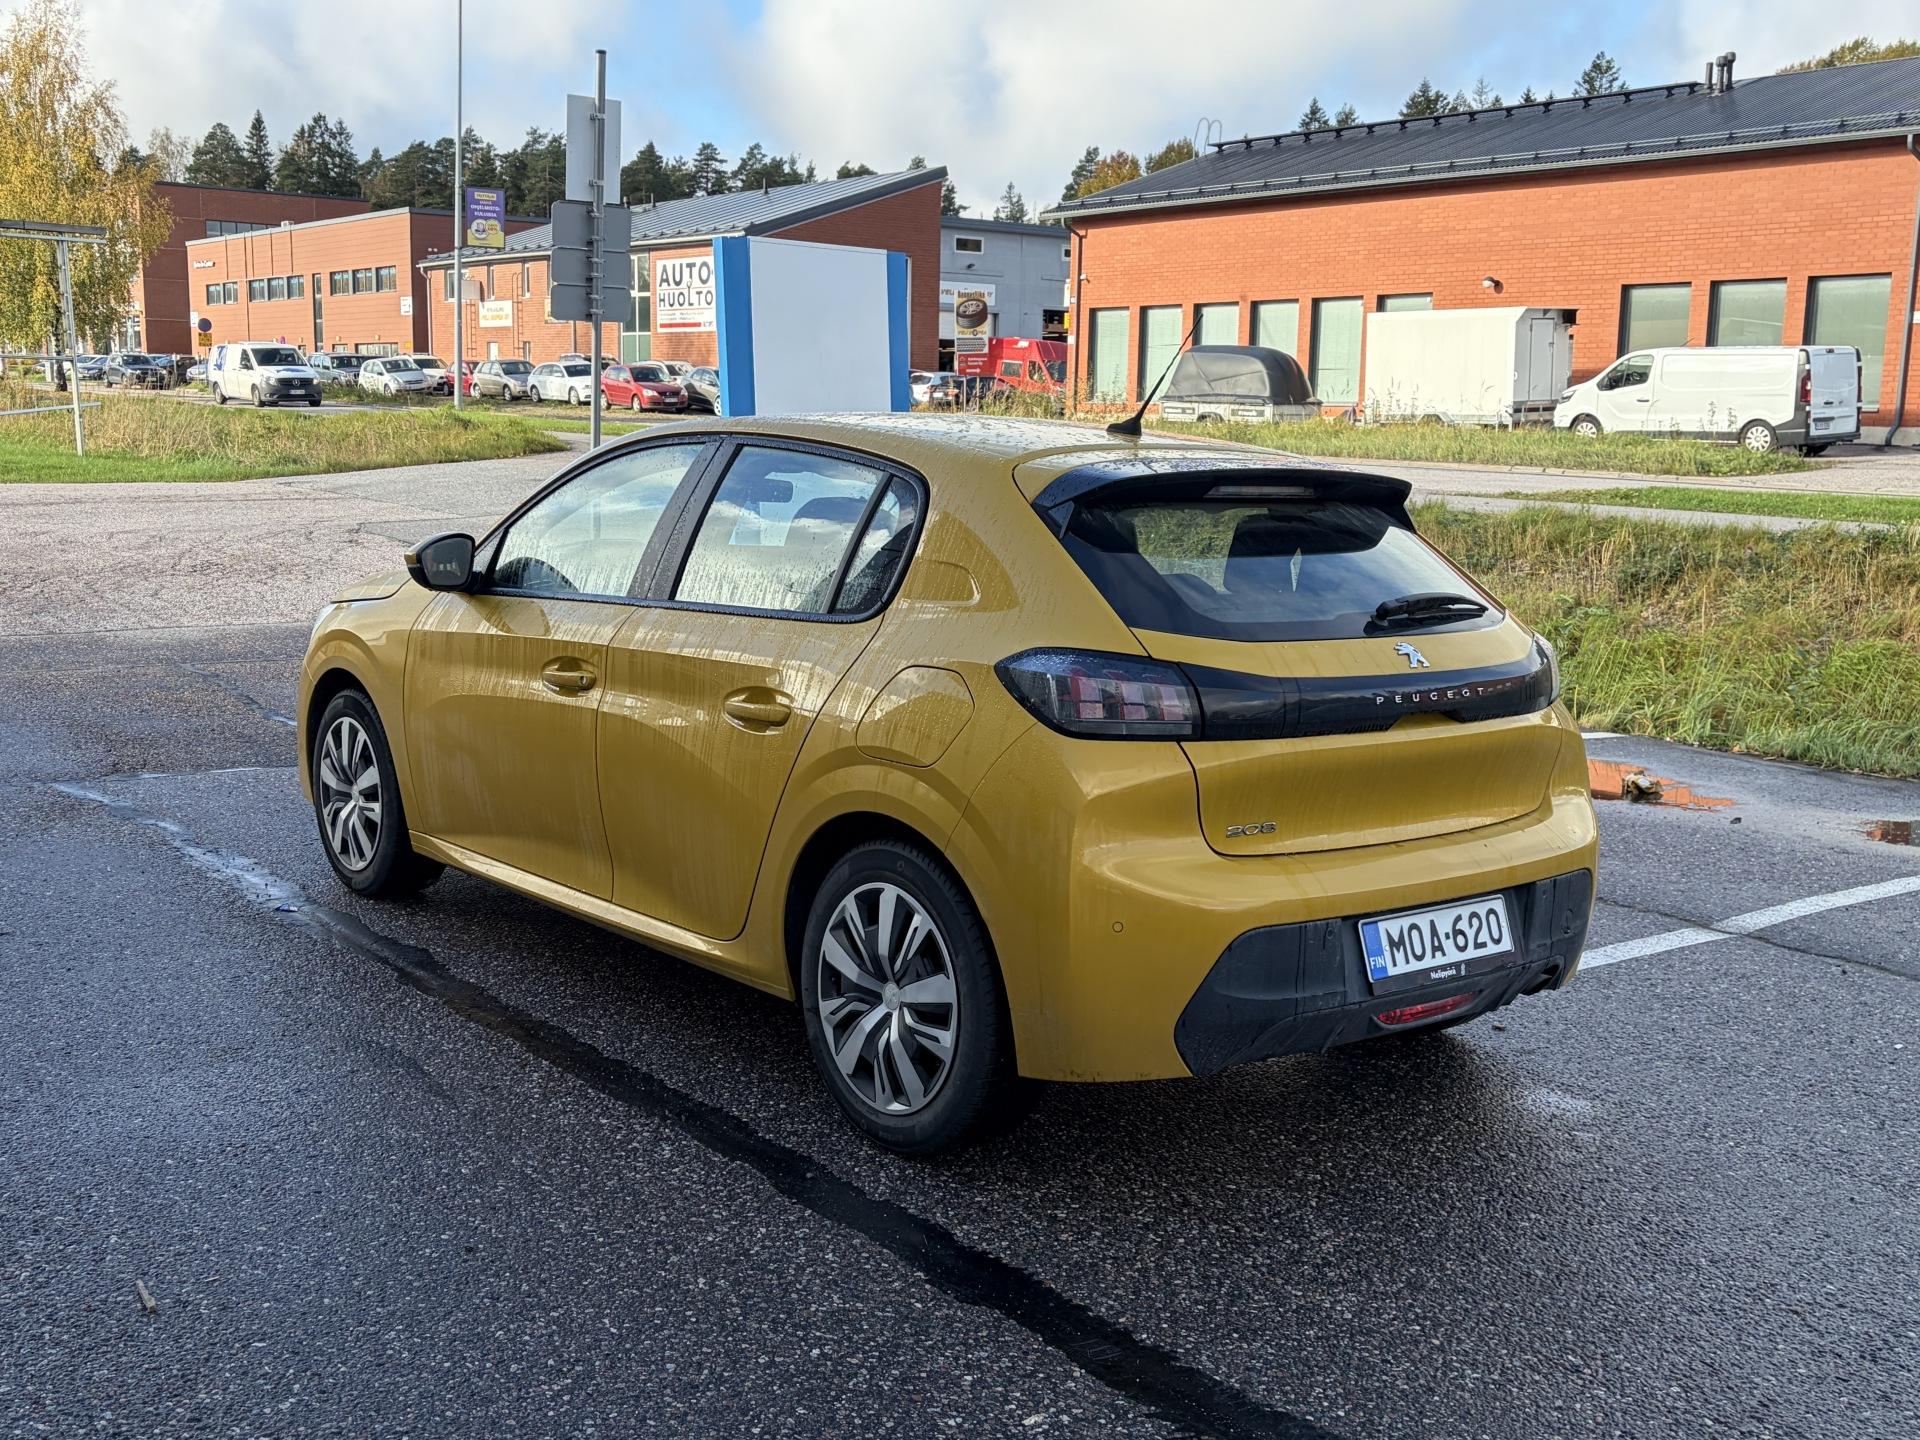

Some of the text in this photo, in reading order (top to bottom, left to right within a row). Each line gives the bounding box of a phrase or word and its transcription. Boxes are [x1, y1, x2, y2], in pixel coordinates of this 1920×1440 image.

[658, 290, 714, 308] HUOLTO
[1376, 687, 1484, 705] PEUGEOT
[1226, 821, 1276, 838] 208
[1385, 907, 1503, 968] MOA-620
[1369, 955, 1386, 970] FIN
[1430, 966, 1457, 980] Nelipyörä
